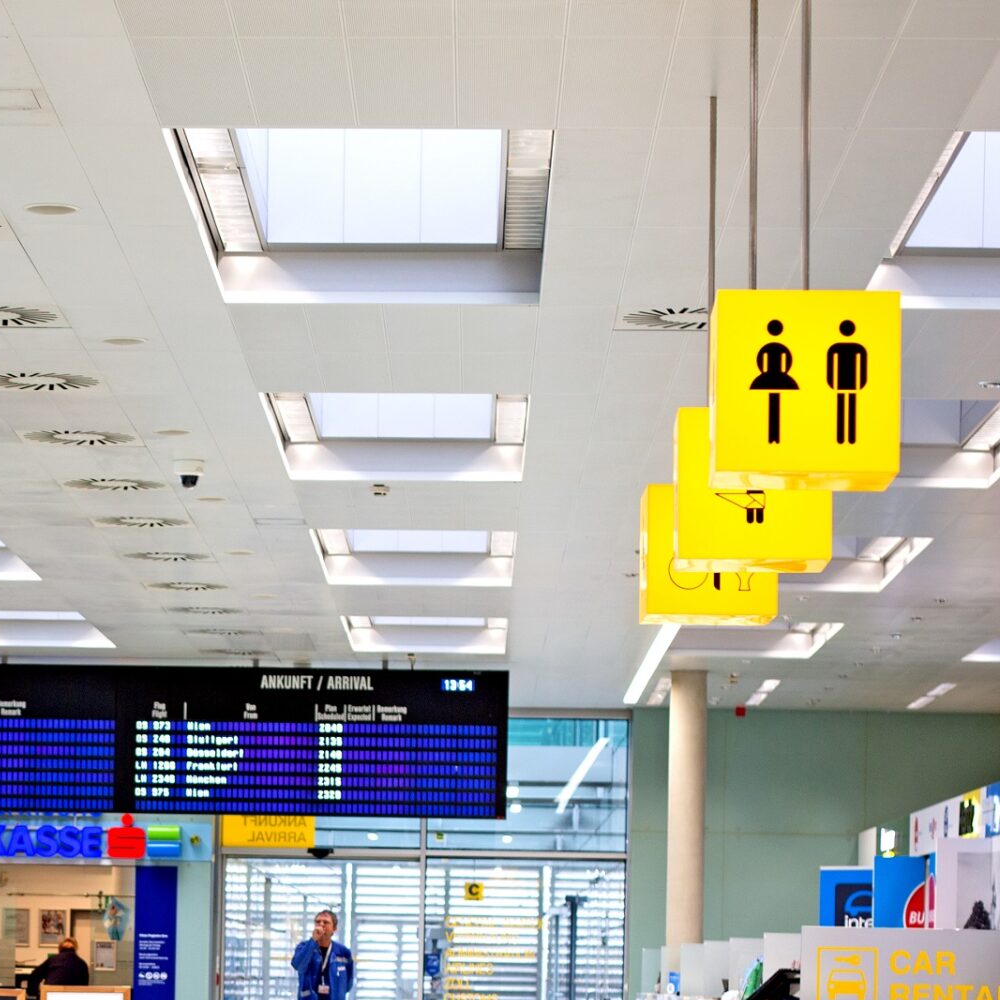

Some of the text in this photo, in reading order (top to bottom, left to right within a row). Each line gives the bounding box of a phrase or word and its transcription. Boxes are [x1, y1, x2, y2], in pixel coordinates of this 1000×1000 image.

[261, 675, 313, 690] ANKUNFT
[327, 676, 373, 691] ARRIVAL
[468, 883, 479, 895] C
[889, 951, 956, 975] CAR
